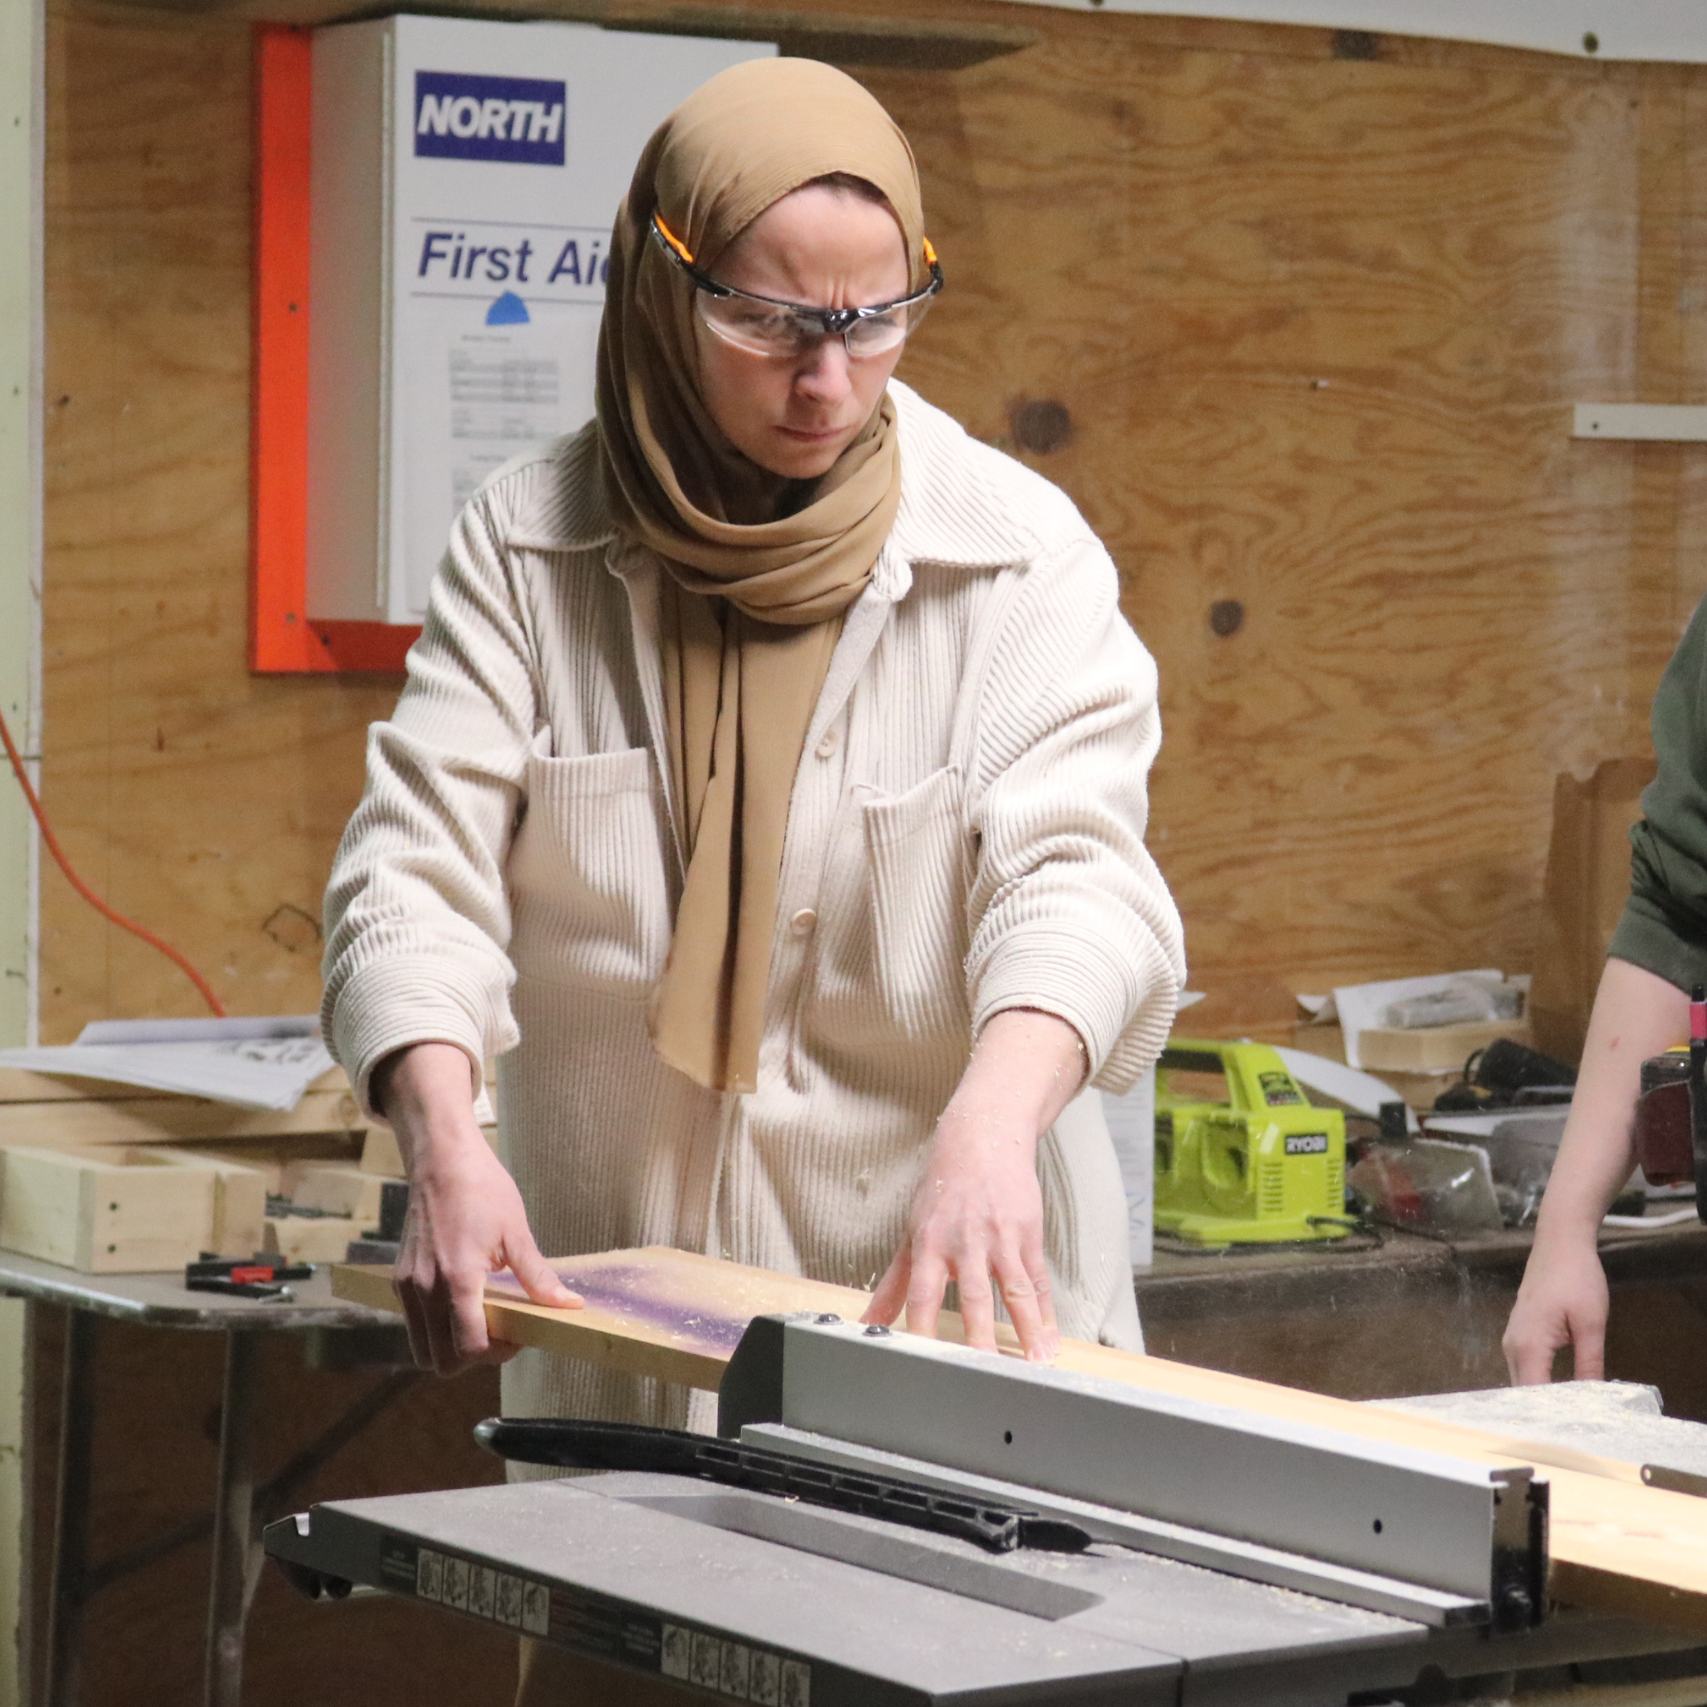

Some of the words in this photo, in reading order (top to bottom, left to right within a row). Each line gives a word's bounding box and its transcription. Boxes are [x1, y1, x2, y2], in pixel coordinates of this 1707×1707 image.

[417, 94, 563, 143] NORTH
[418, 232, 532, 282] First
[1286, 1135, 1327, 1153] RYOBI
